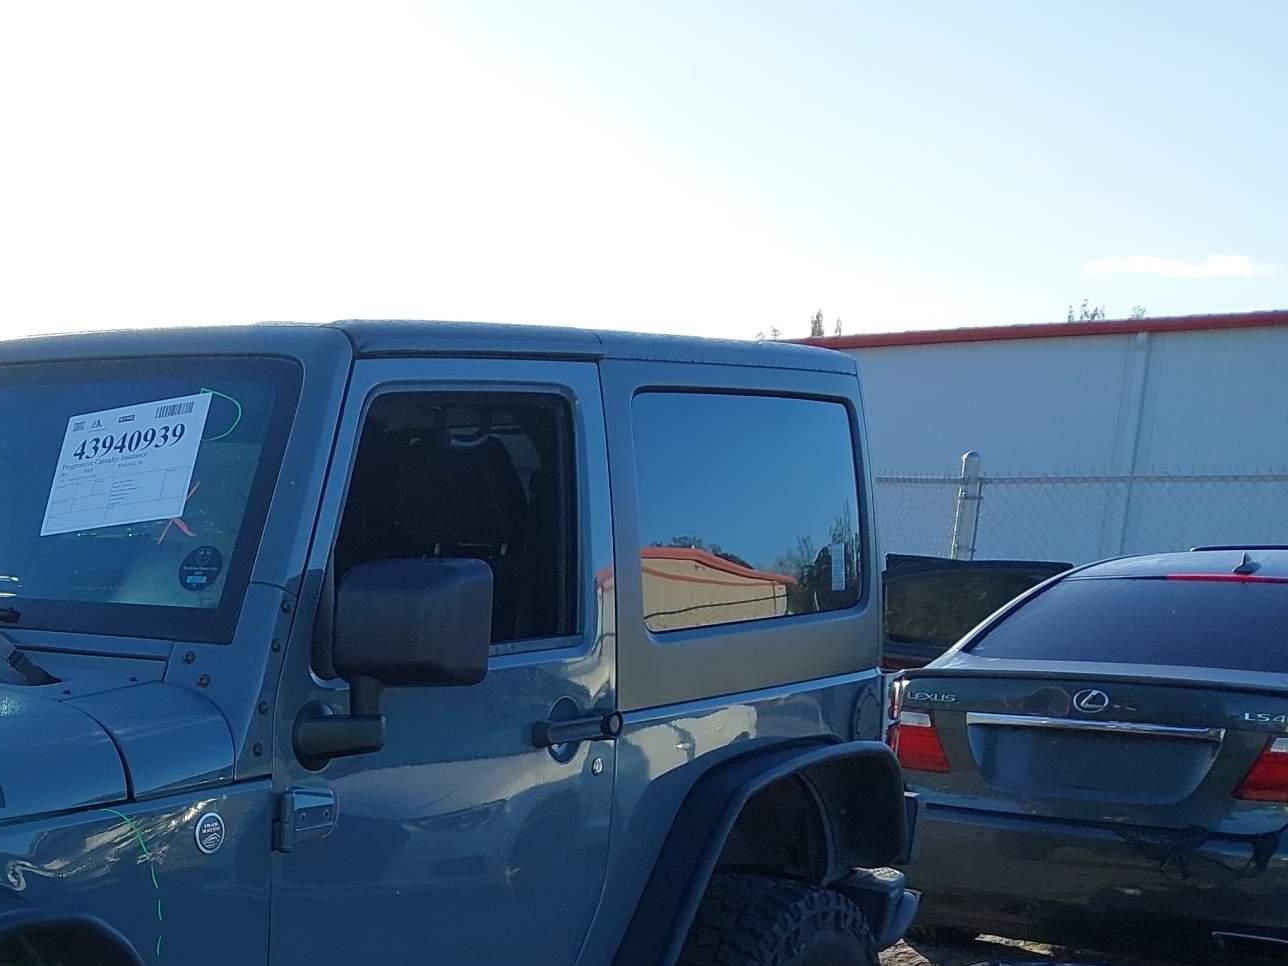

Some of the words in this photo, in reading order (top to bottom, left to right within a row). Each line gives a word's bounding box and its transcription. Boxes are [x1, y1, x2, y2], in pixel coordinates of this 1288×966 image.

[72, 423, 185, 460] 43940939
[907, 691, 958, 702] LEXUS
[1244, 712, 1288, 723] LS4
